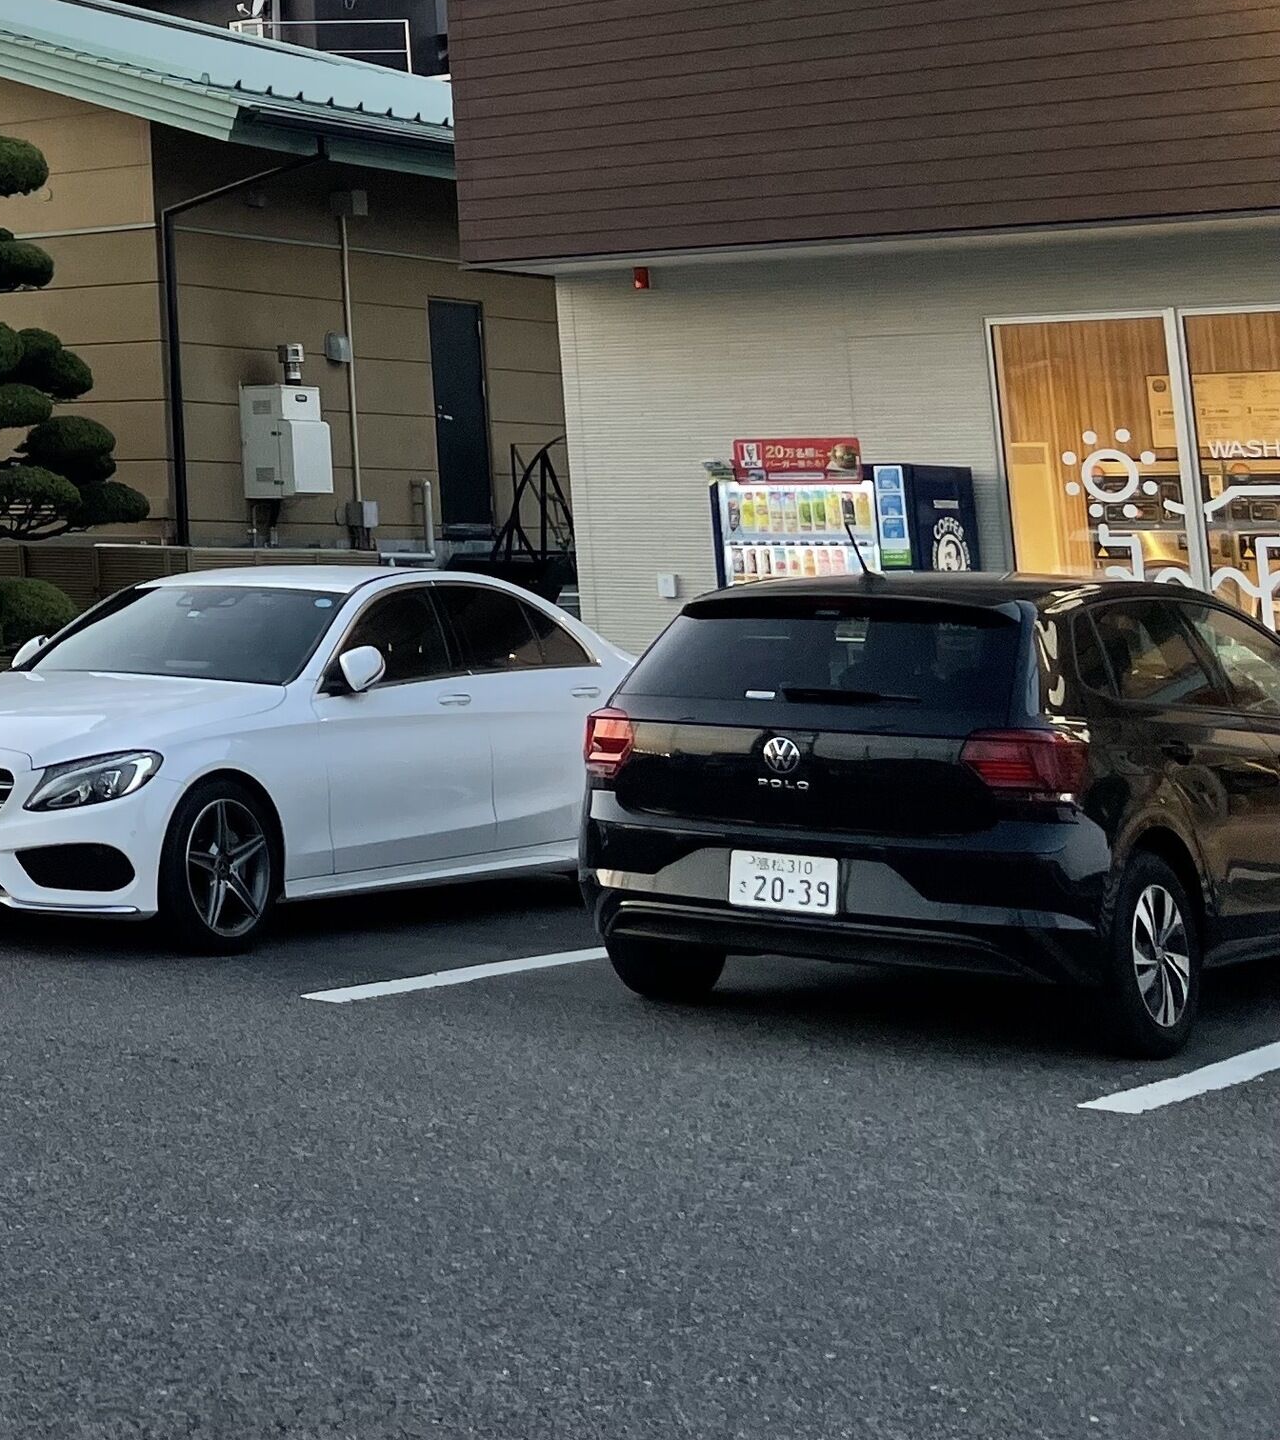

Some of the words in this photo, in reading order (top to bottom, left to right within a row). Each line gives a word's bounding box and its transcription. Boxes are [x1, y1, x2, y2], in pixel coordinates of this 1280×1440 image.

[758, 778, 809, 790] POLO
[787, 859, 813, 875] 310
[753, 875, 829, 907] 20-39
